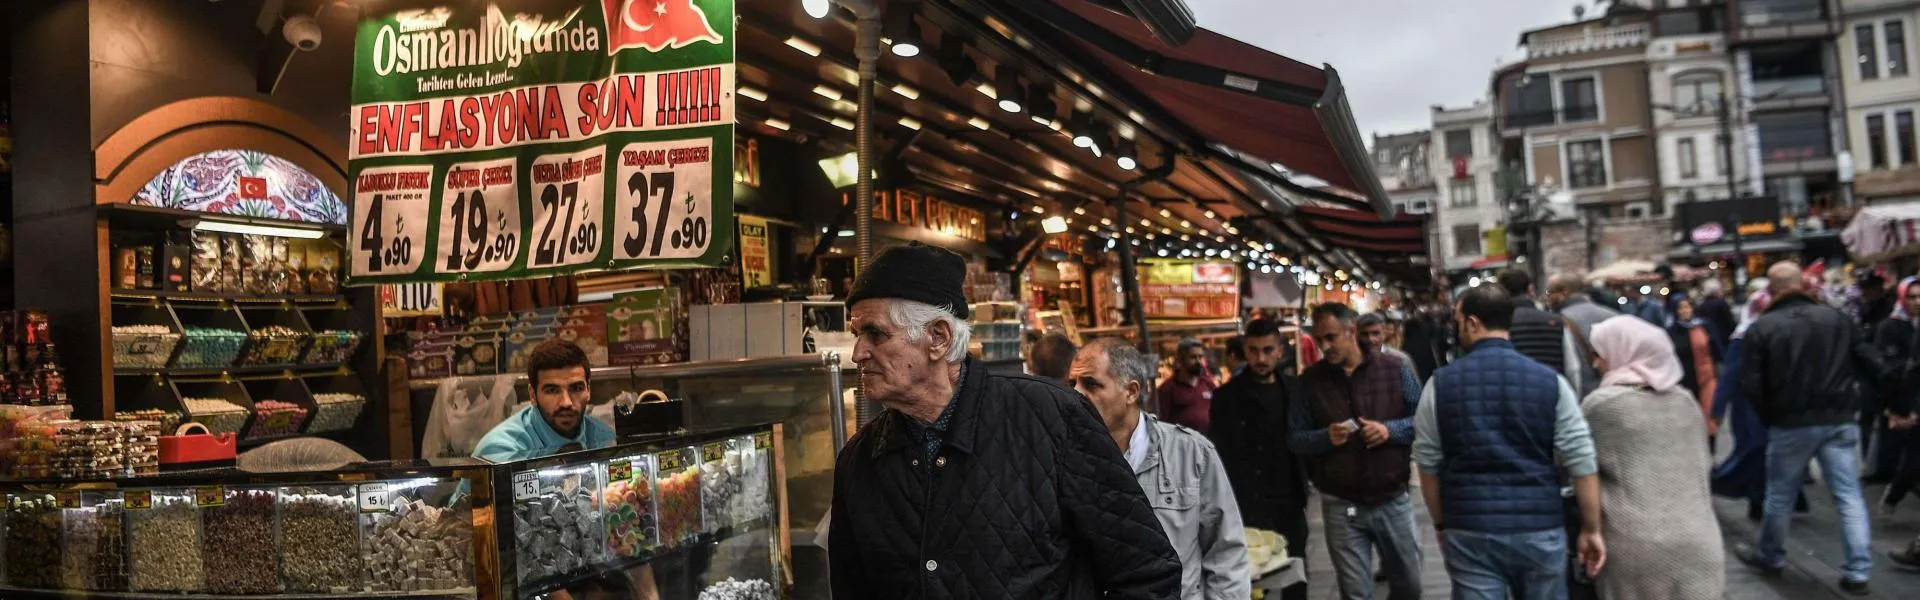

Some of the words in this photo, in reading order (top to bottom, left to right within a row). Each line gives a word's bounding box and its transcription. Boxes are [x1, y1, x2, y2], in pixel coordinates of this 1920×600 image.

[417, 75, 454, 93] Tarihten
[456, 72, 483, 89] Gelen
[358, 86, 570, 155] ENFLASYONA
[578, 75, 647, 136] SON
[656, 67, 722, 126] !!!!!!
[622, 149, 666, 171] YAŞAM
[358, 172, 396, 194] KABUKLU
[396, 171, 430, 190] FISTIK
[448, 166, 480, 190] SÜPER
[482, 165, 513, 191] ÇEREZ
[533, 162, 562, 185] ULTRA
[561, 158, 583, 182] SÜPER
[385, 193, 402, 201] PAKET
[523, 481, 534, 495] 15
[368, 495, 377, 505] 15
